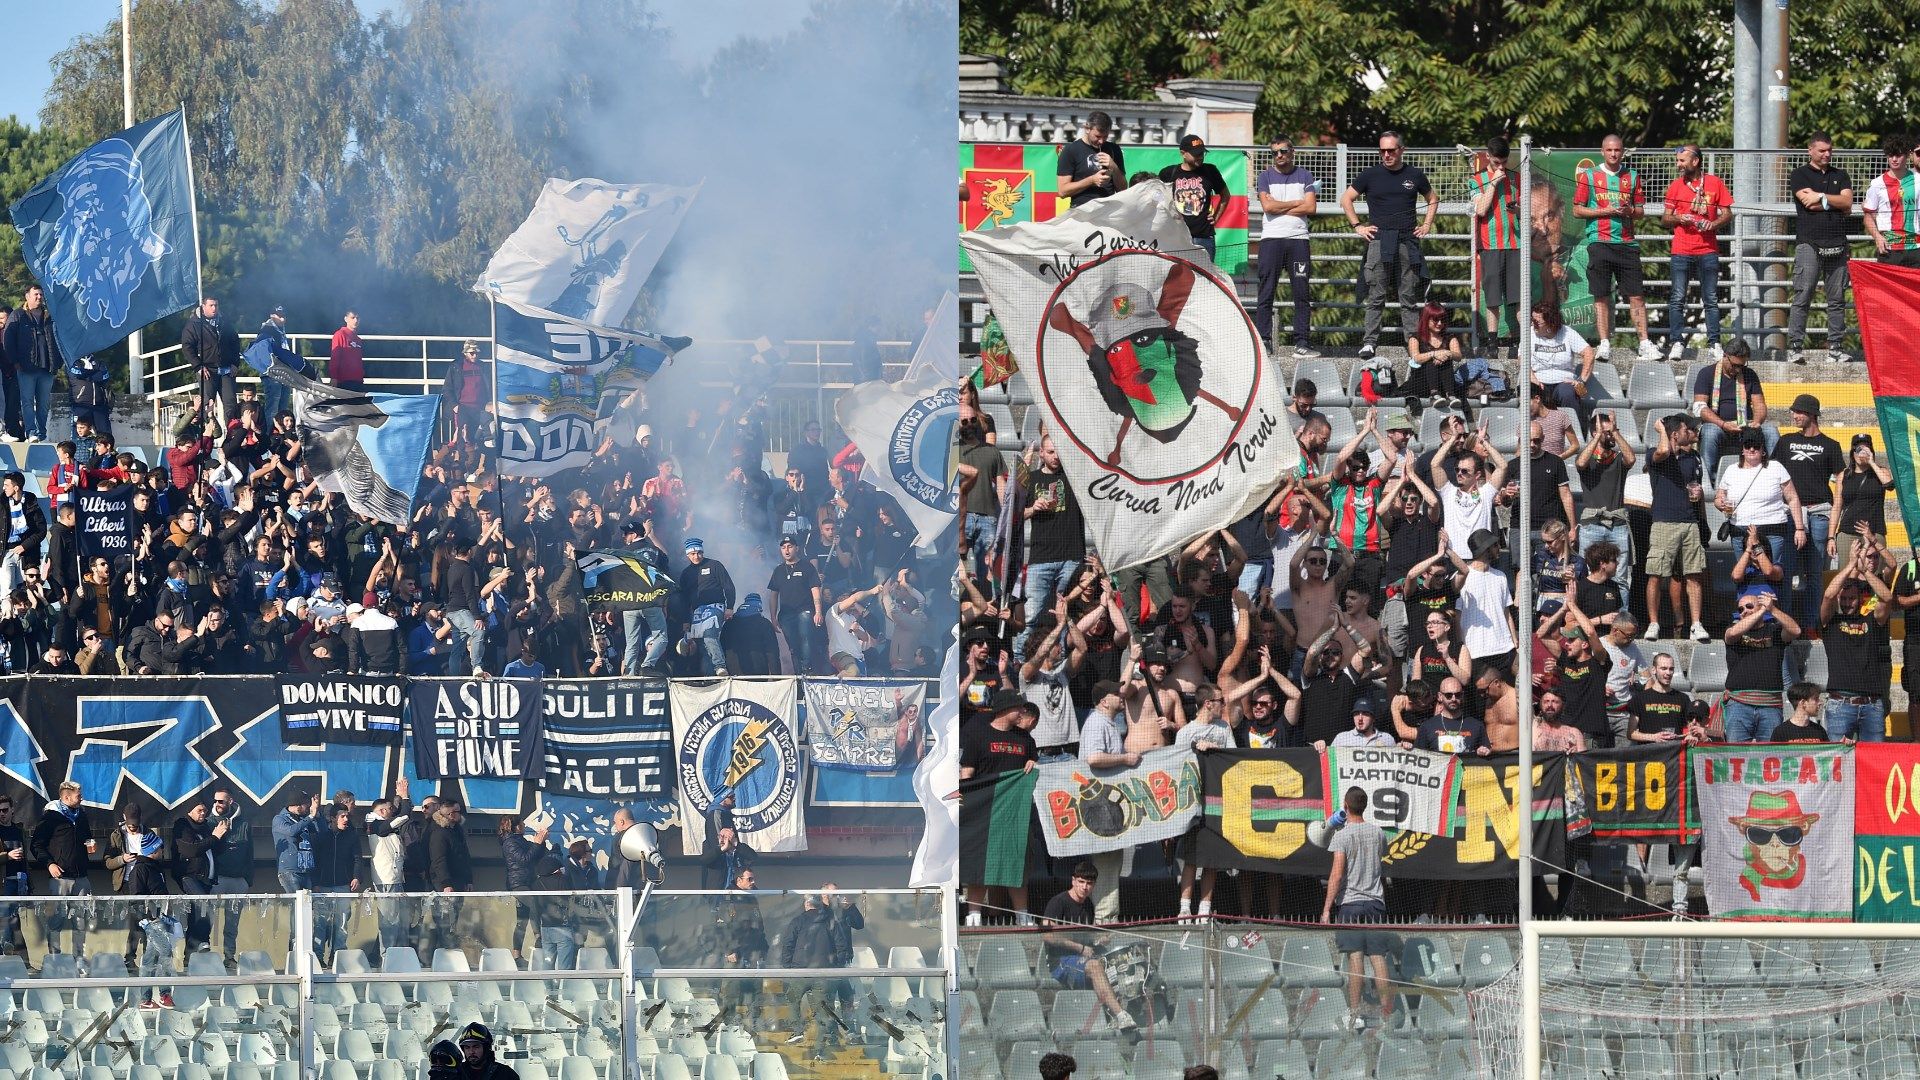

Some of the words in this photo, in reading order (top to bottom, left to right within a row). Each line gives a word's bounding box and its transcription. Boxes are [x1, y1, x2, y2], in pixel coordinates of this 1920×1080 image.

[1039, 252, 1080, 284] The
[1085, 231, 1159, 259] Furies
[1790, 443, 1824, 453] Reebok
[1088, 473, 1163, 514] Curva
[1167, 466, 1224, 511] Nord
[1223, 408, 1277, 474] Terni
[80, 496, 127, 512] Ultras
[85, 516, 125, 533] Liberi
[101, 536, 127, 548] 1936
[282, 682, 401, 706] DOMENICO
[435, 684, 457, 719] A
[459, 682, 520, 719] SUD
[807, 684, 895, 709] MICHEL
[318, 709, 366, 732] VIVE
[457, 719, 496, 738] DEL
[684, 717, 713, 754] VECCHIA
[709, 700, 752, 721] GUARDIA
[437, 738, 521, 776] FIUME
[812, 742, 895, 765] SEMPRE
[1352, 750, 1431, 769] CONTRO
[1339, 767, 1441, 789] L'ARTICOLO
[1703, 756, 1842, 786] INTACCATI
[761, 777, 796, 824] CONTINUA
[1372, 787, 1410, 825] 9
